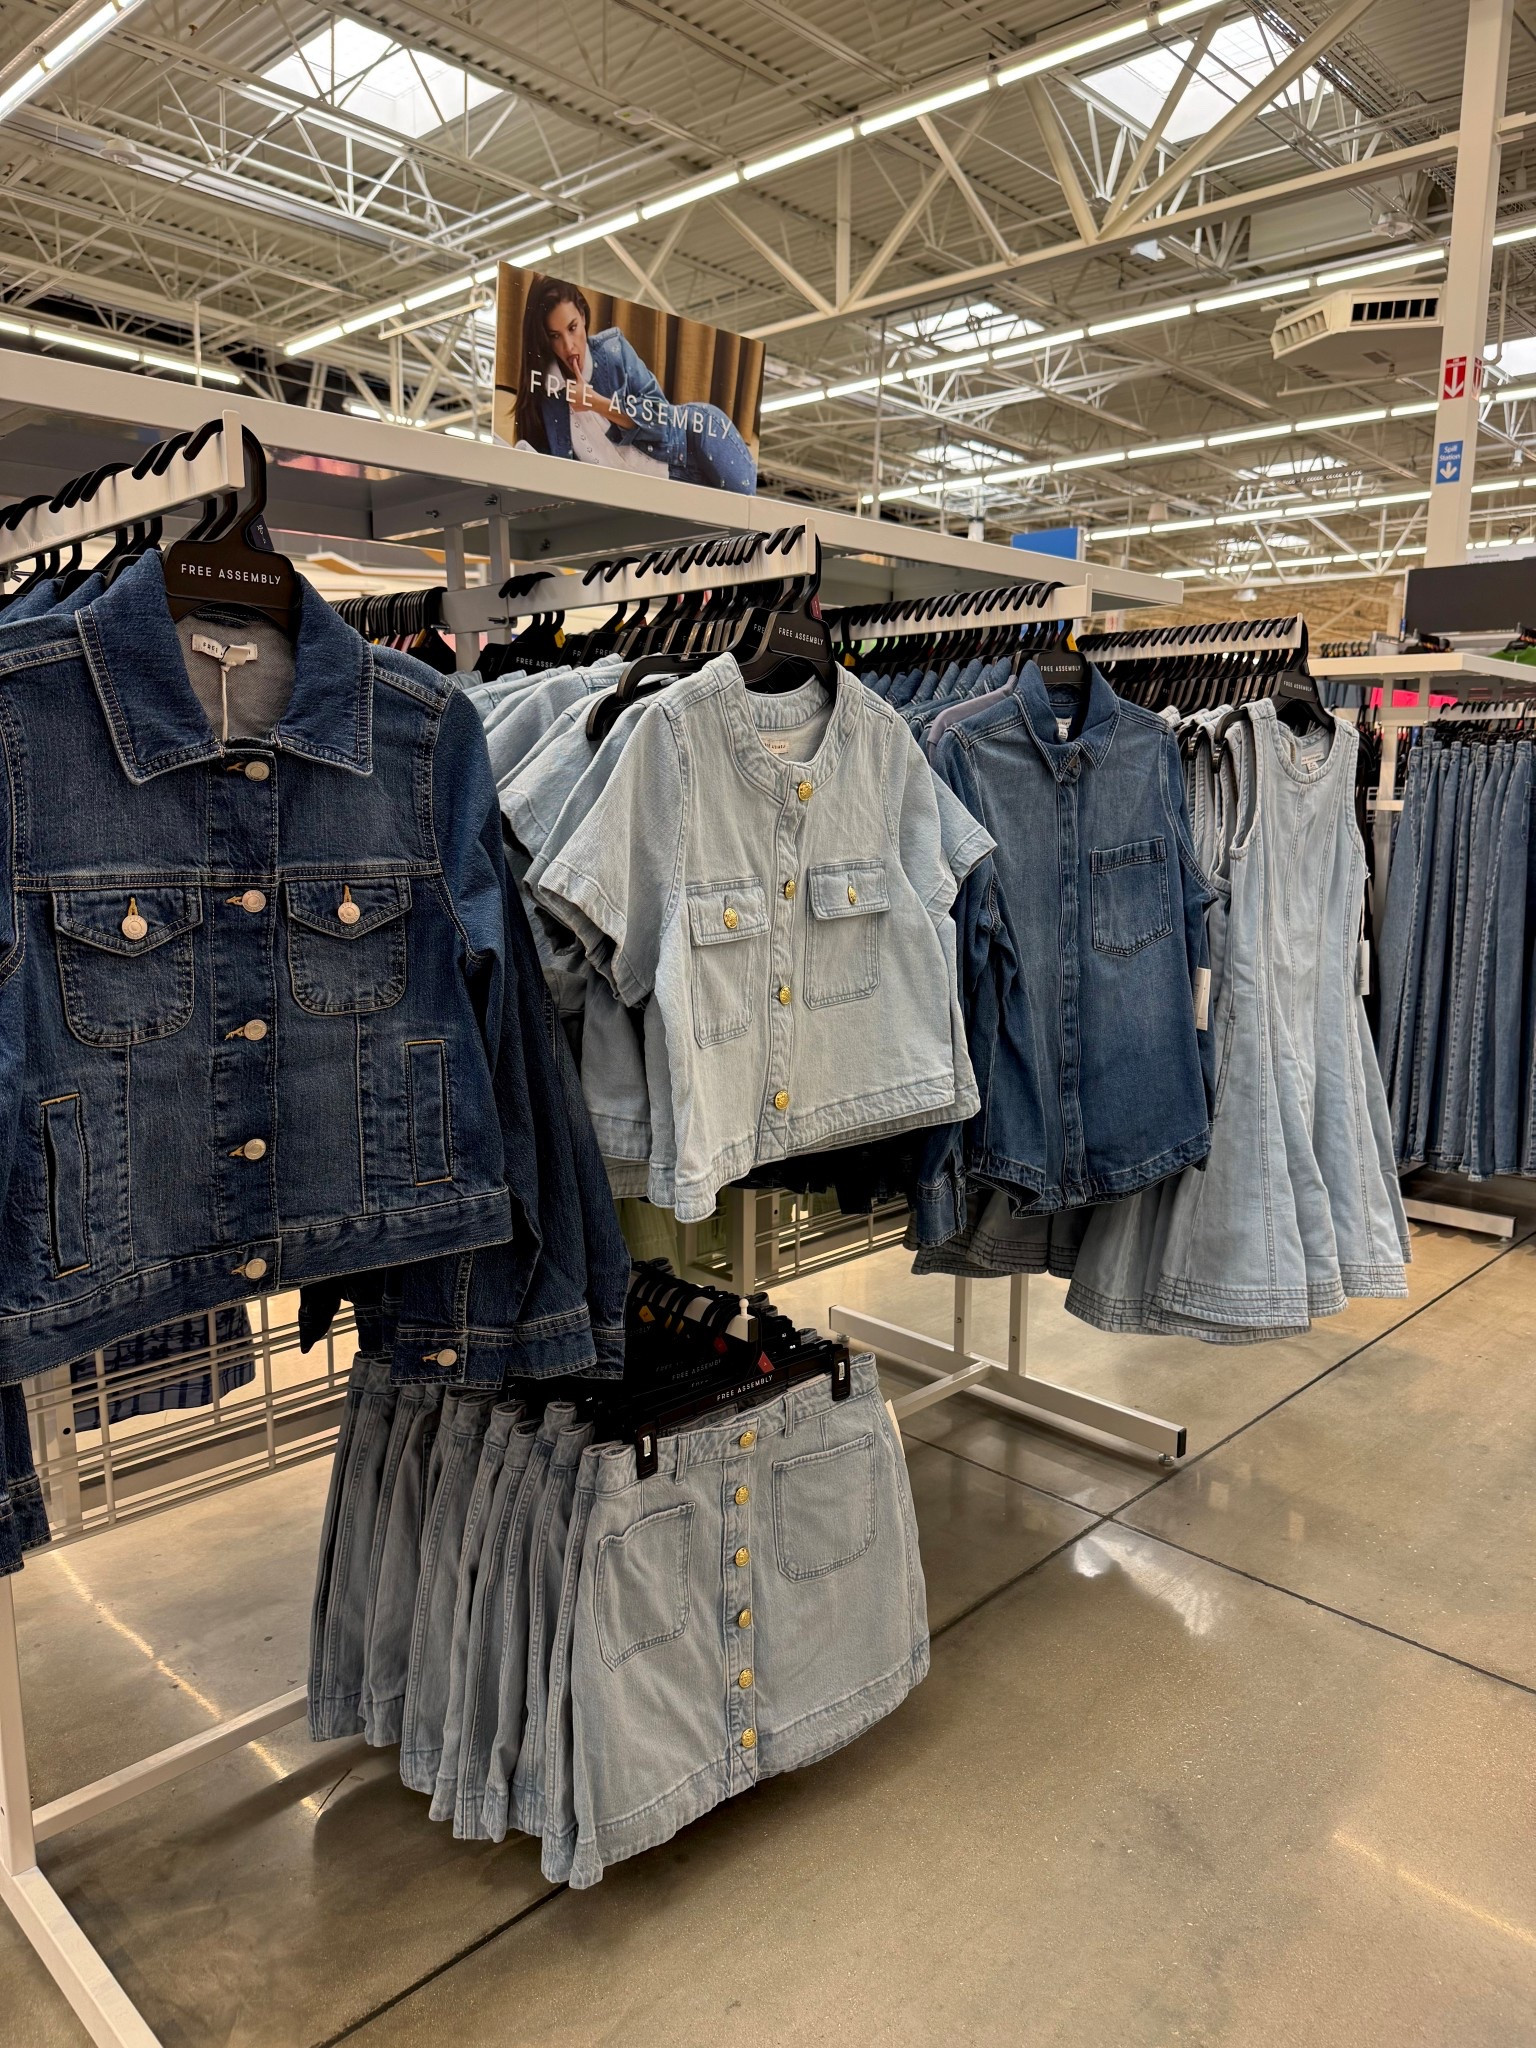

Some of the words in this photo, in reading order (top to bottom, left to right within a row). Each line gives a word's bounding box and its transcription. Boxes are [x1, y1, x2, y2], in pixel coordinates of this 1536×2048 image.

[530, 370, 593, 407] FREE
[609, 391, 733, 440] ASSEMBLY
[181, 563, 212, 577] FREE
[218, 568, 281, 585] ASSEMBLY
[778, 627, 793, 638] FREE
[794, 632, 824, 646] ASSEMBLY
[515, 656, 533, 666] FREE
[716, 1389, 735, 1401] FREE
[737, 1374, 773, 1394] ASSEMBLY
